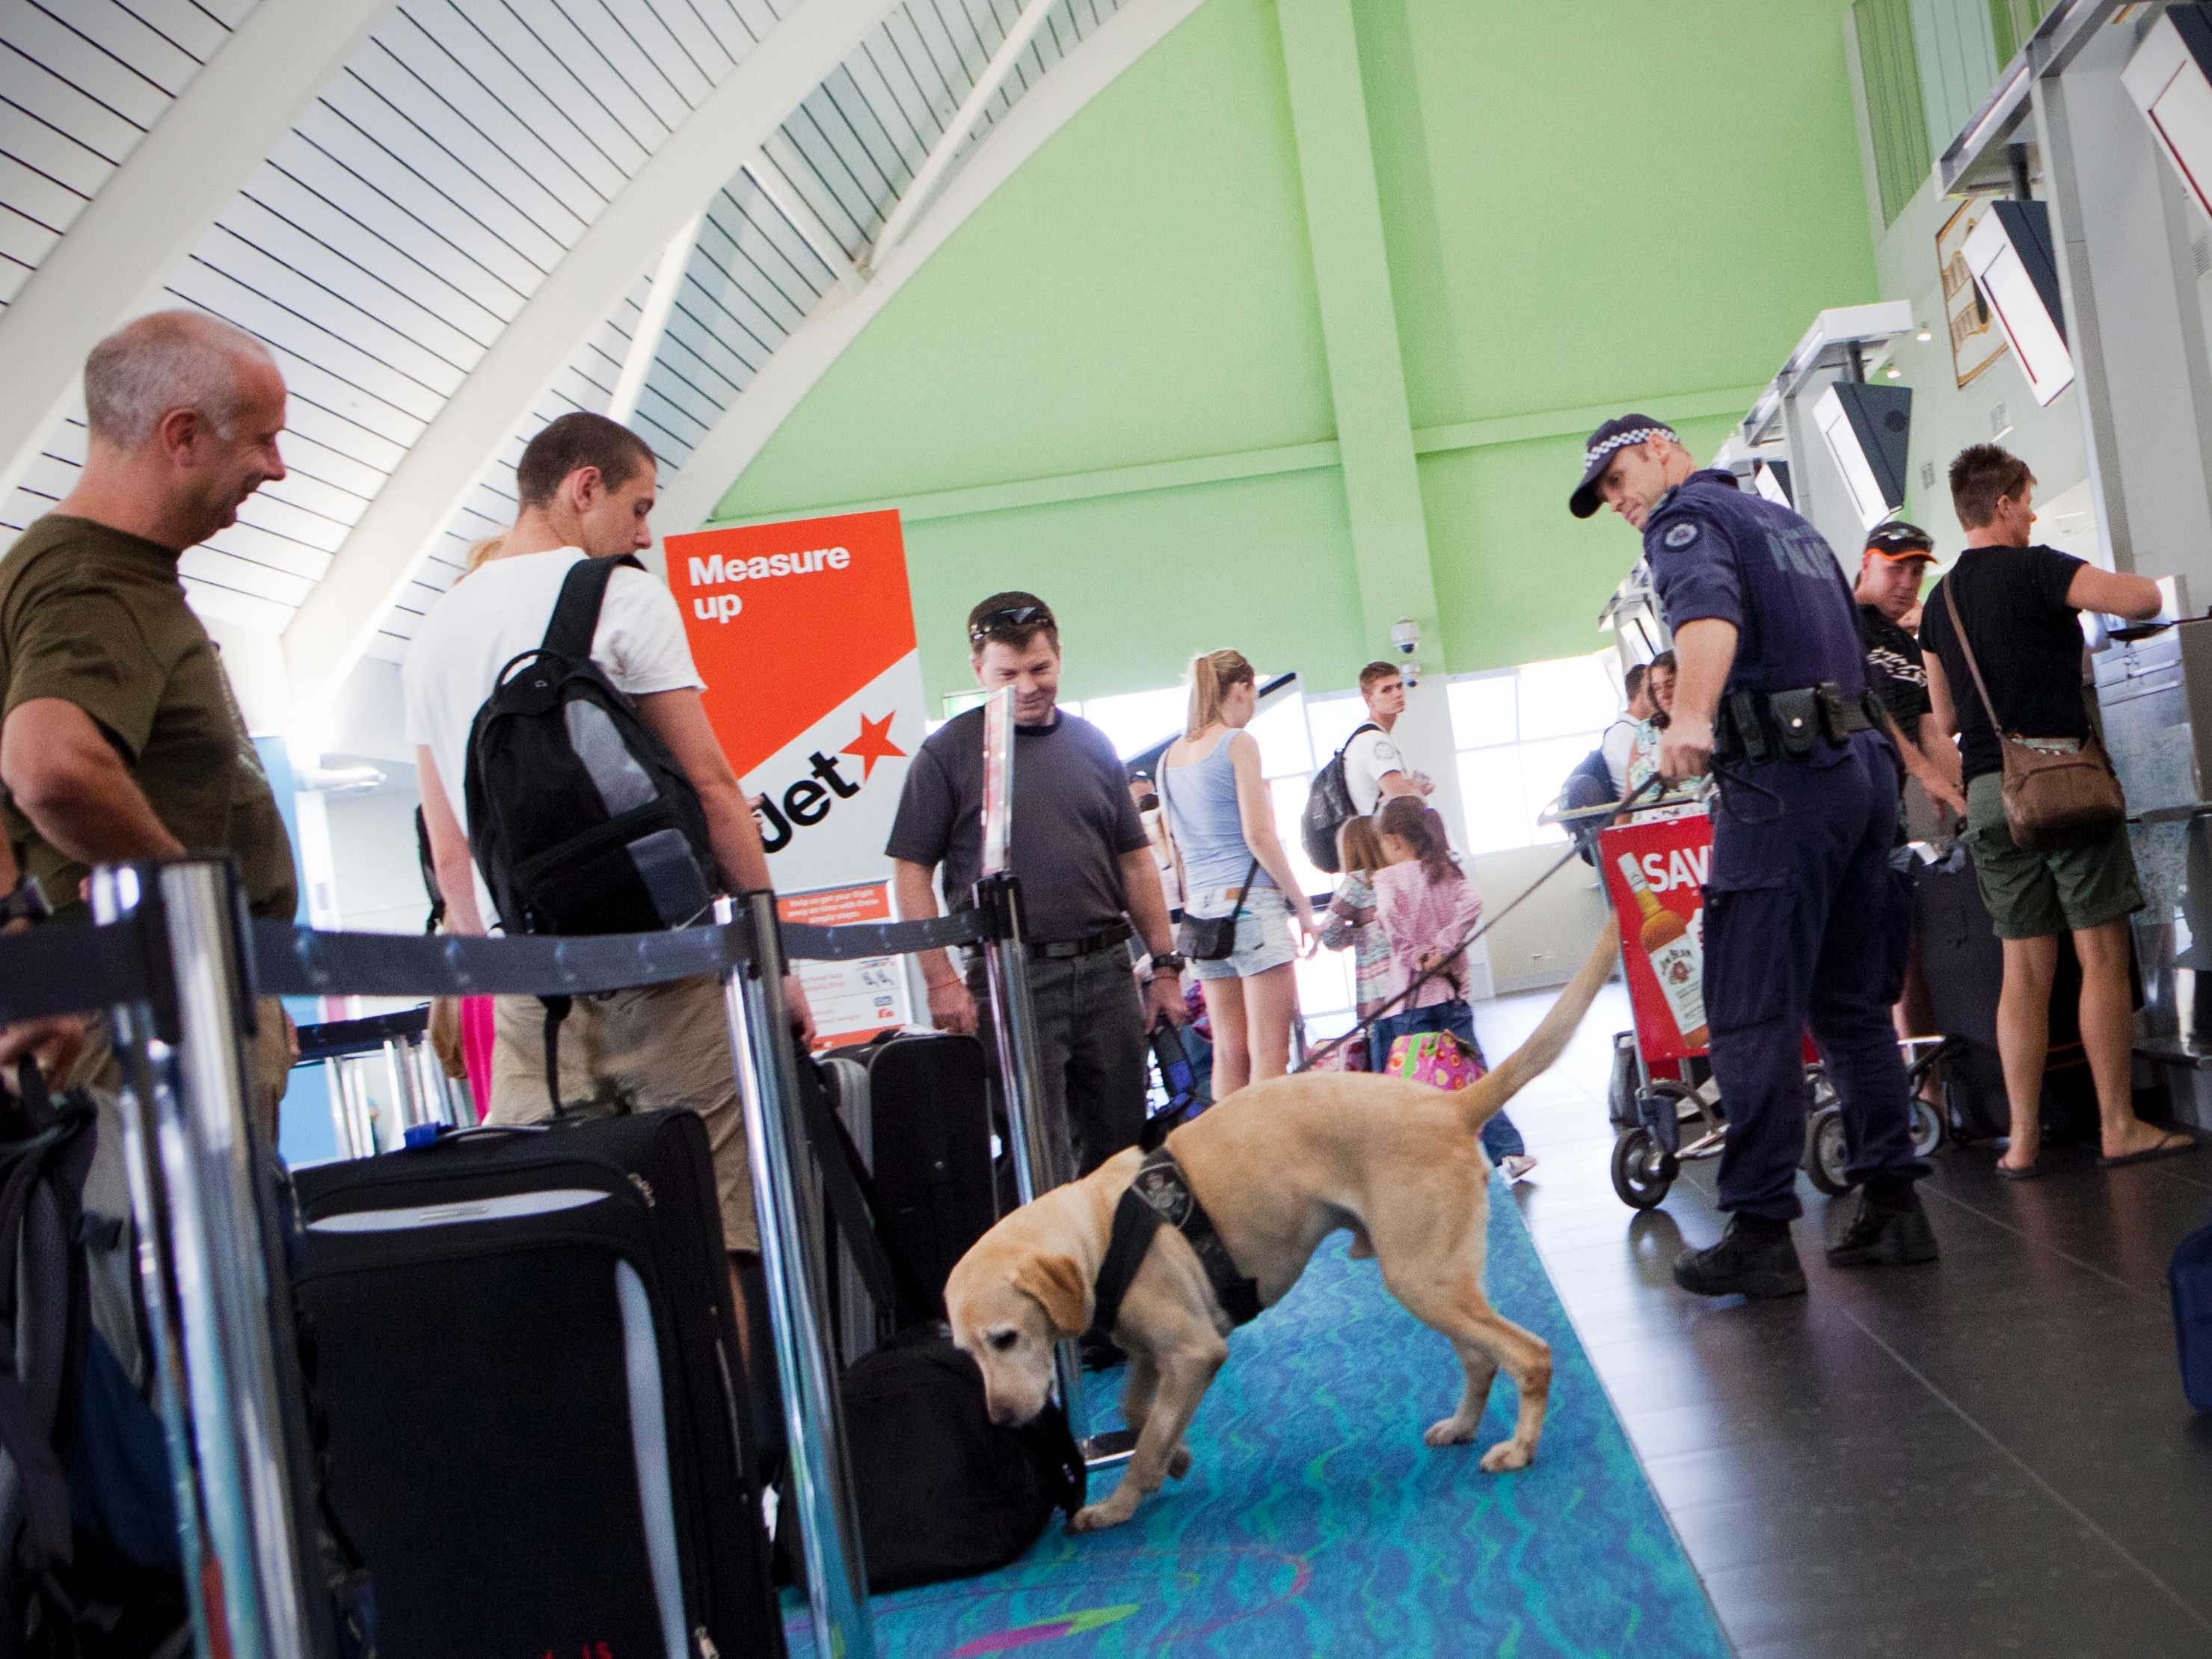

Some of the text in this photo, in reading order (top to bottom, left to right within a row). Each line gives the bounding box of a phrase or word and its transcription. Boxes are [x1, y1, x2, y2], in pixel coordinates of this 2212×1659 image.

[688, 547, 850, 586] Measure
[694, 594, 743, 624] up
[758, 751, 861, 854] Jet
[1641, 846, 1714, 893] SAV
